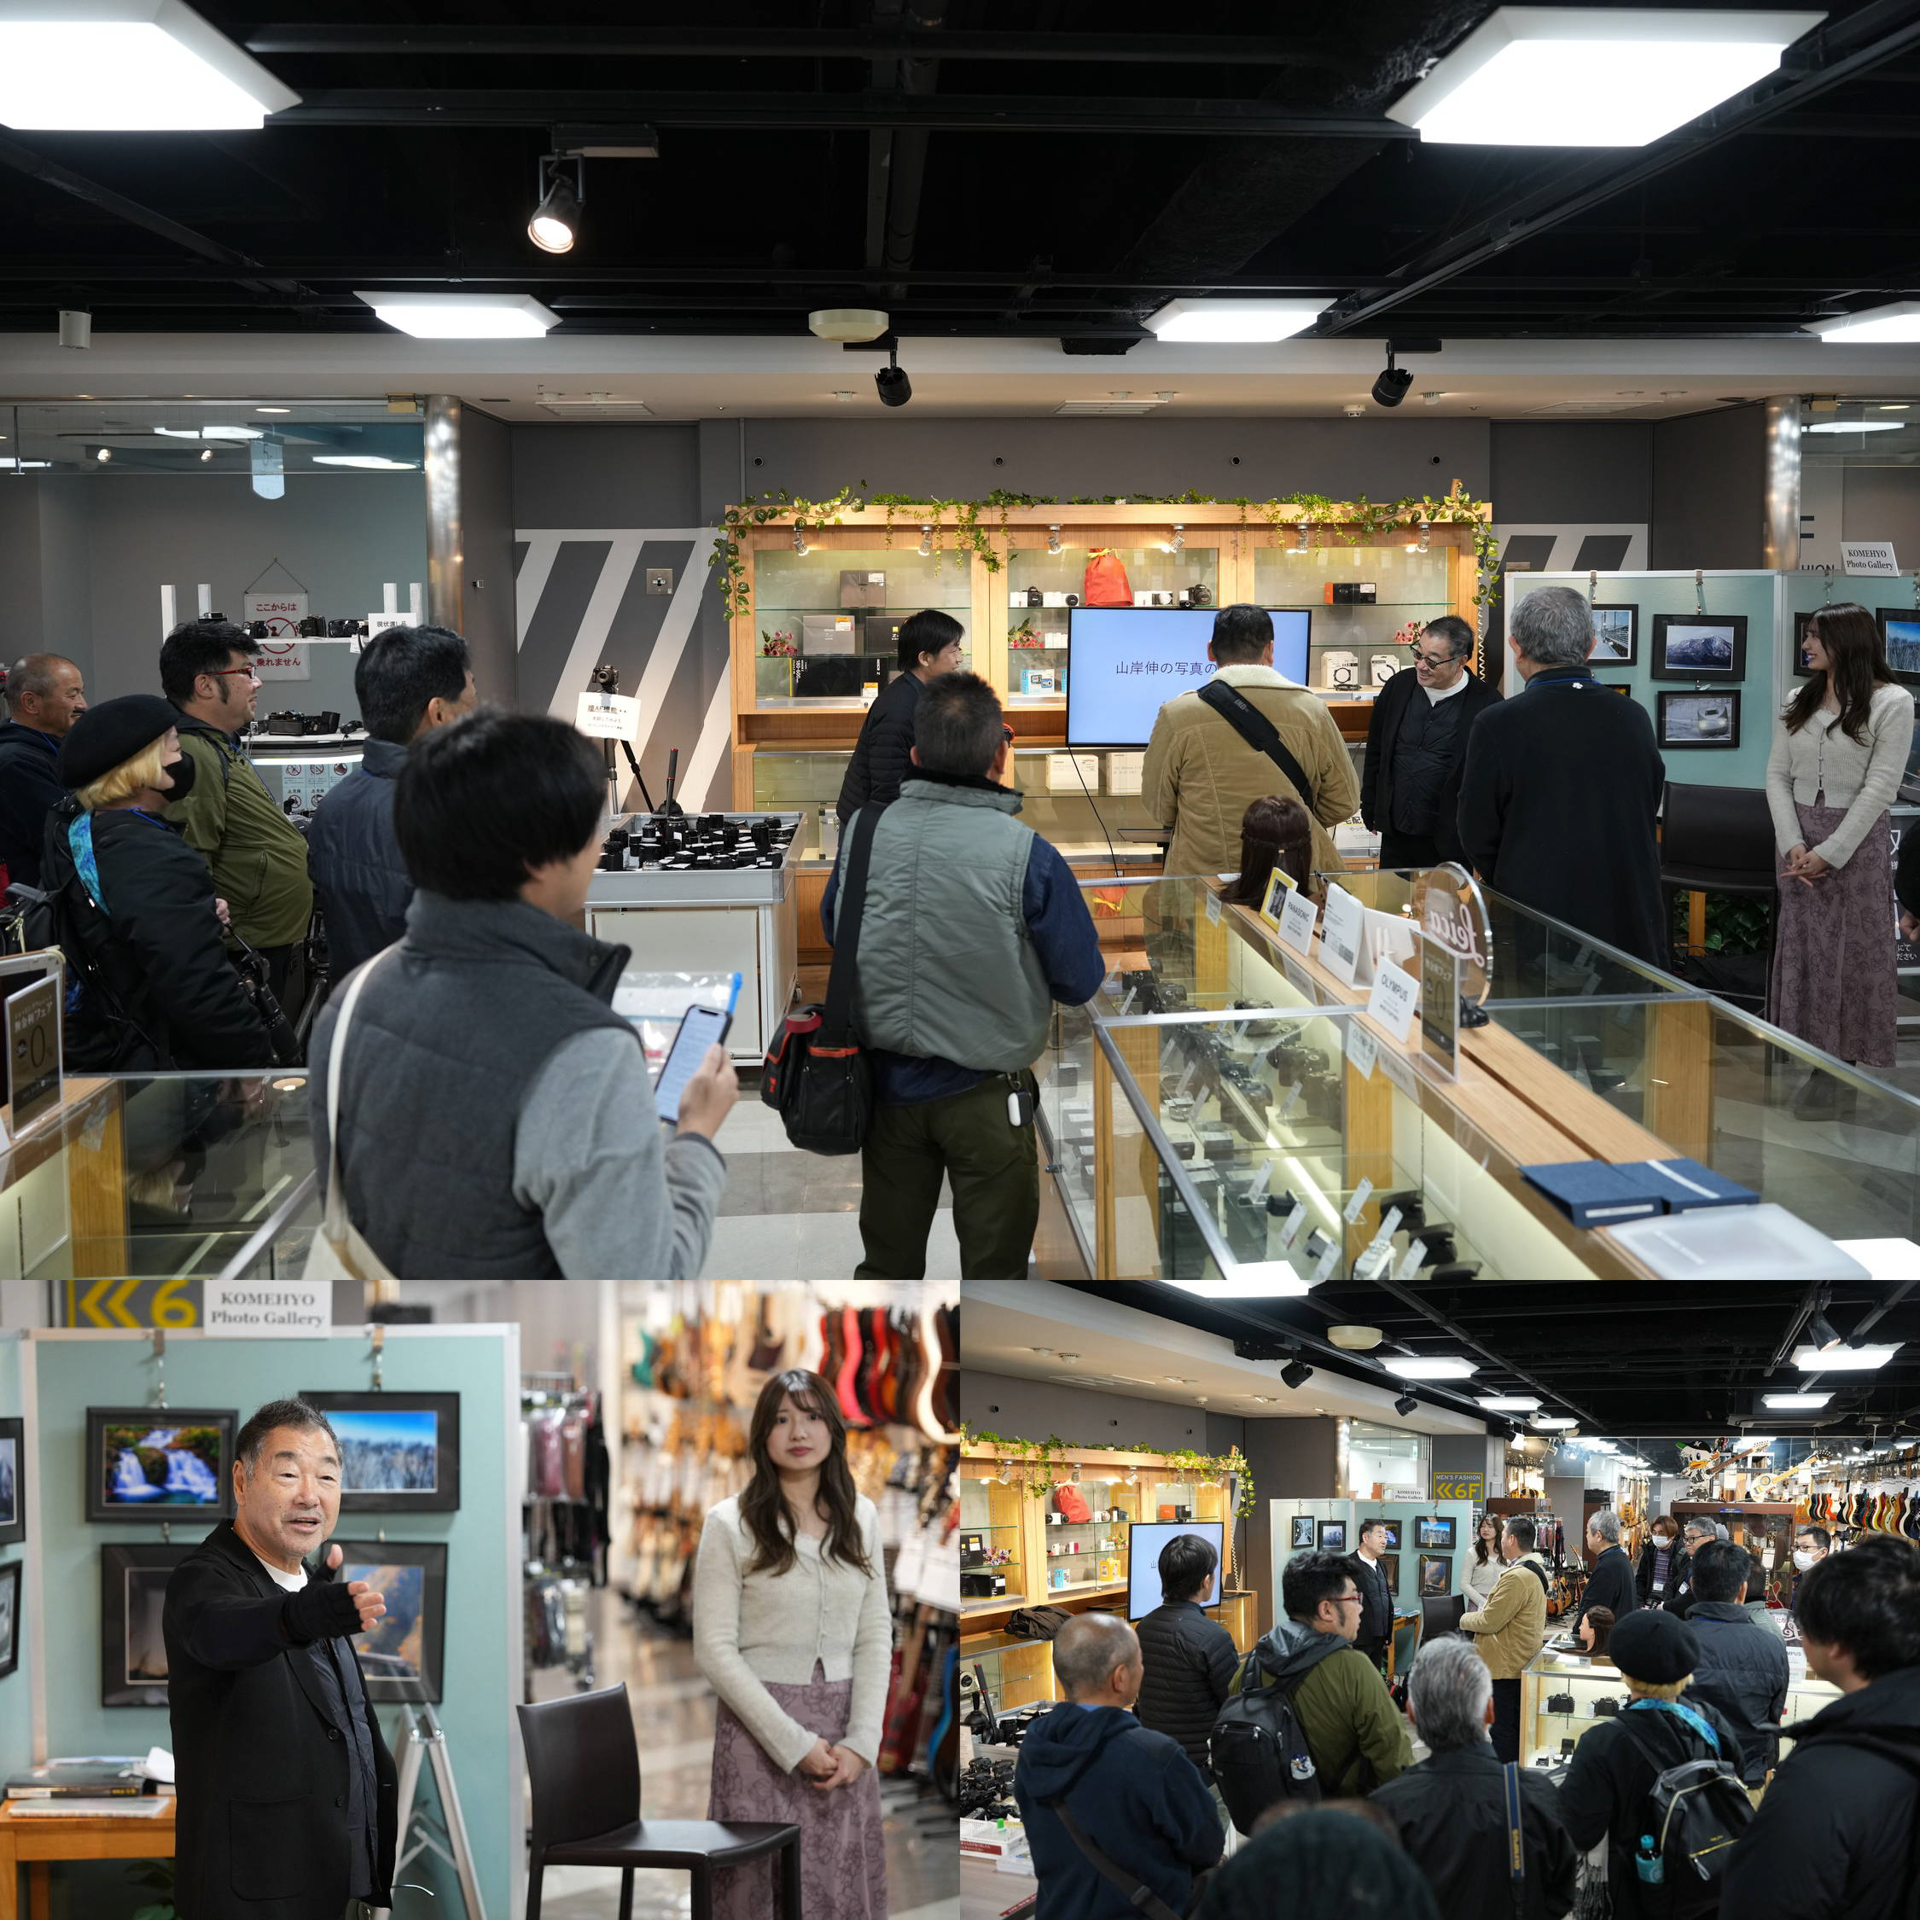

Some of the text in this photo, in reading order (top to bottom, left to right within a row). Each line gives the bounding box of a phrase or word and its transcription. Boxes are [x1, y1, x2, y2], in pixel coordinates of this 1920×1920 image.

[1847, 549, 1887, 558] KOMEHYO
[1846, 560, 1894, 571] Photo Gallery
[256, 602, 298, 612] ここからは
[256, 658, 301, 667] 乗れません
[1115, 661, 1218, 676] 山岸伸の写真の
[1288, 901, 1310, 922] PANASONIC
[1381, 973, 1409, 1002] OLYMPUS
[152, 1280, 198, 1328] 6
[220, 1291, 316, 1306] KOMEHYO
[210, 1310, 326, 1328] Photo Gallery
[1455, 1482, 1481, 1499] 6F
